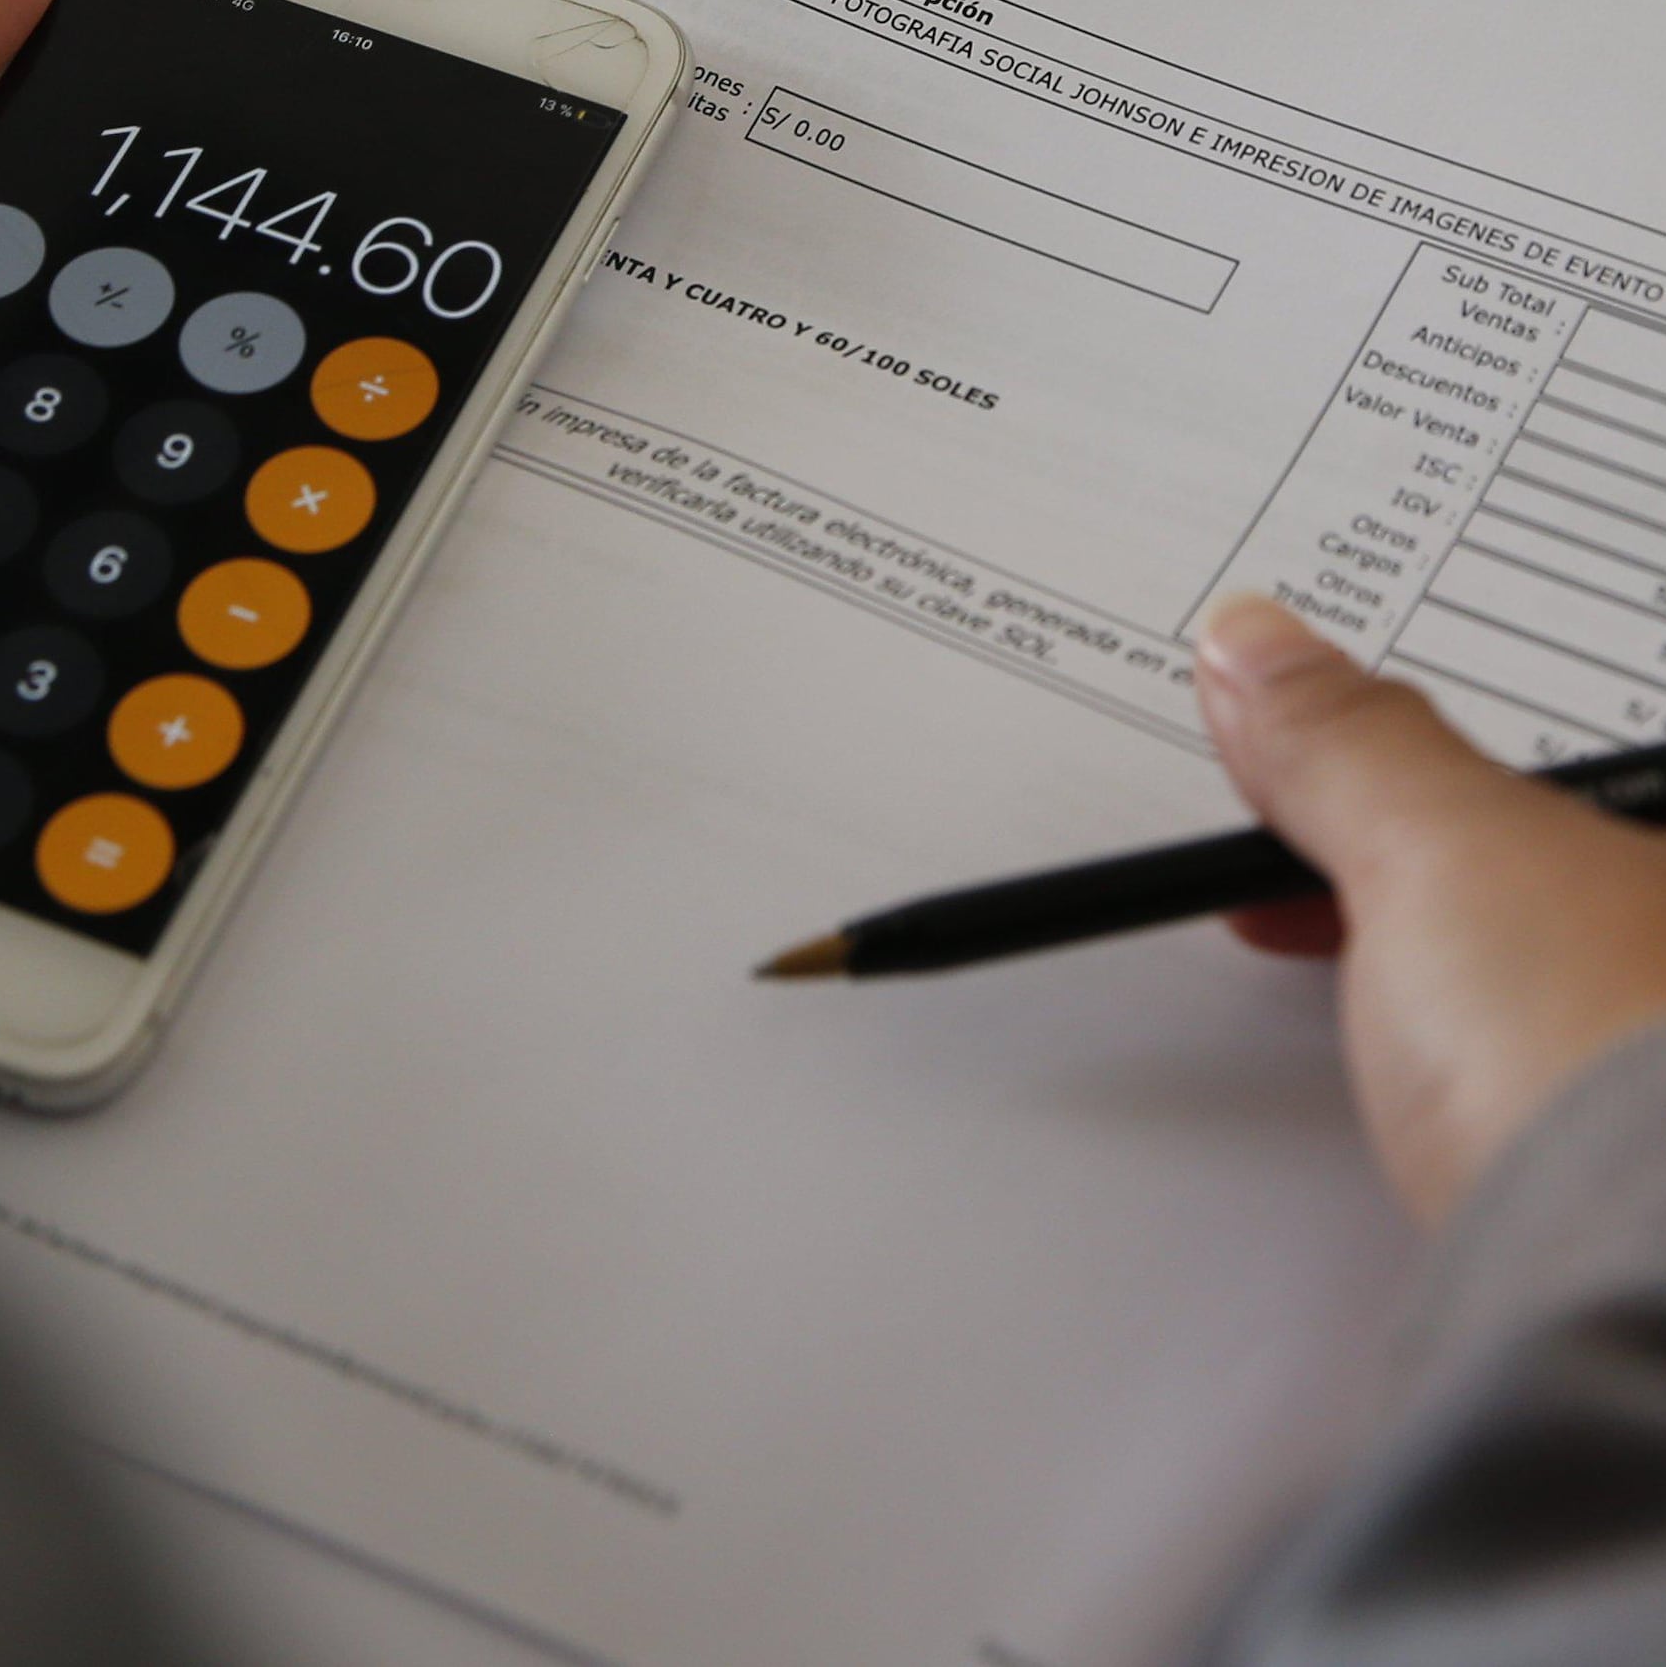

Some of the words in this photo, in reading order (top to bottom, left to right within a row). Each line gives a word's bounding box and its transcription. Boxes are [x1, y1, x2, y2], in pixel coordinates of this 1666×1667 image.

[332, 28, 374, 51] 16:10
[538, 97, 557, 112] 13
[761, 106, 791, 130] S/
[793, 120, 846, 152] 0.00
[979, 48, 1064, 94] SOCIAL
[1068, 83, 1185, 137] JOHNSON
[1189, 126, 1208, 145] E
[1210, 135, 1346, 195] IMPRESION
[1349, 182, 1387, 208] DE
[1389, 196, 1521, 252] IMAGENES
[1524, 241, 1560, 267] DE
[1565, 256, 1665, 304] EVENTO
[90, 124, 503, 320] 1,144.60
[1442, 265, 1489, 294] Sub
[1499, 282, 1557, 317] Total
[665, 273, 684, 291] Y
[685, 282, 787, 331] CUATRO
[794, 322, 812, 338] Y
[814, 330, 911, 378] 60/100
[913, 368, 1001, 411] SOLES
[1461, 301, 1539, 343] Ventas
[1411, 325, 1522, 376] Anticipos
[24, 386, 63, 423] 8
[1362, 350, 1501, 412] Descuentos
[1344, 385, 1407, 420] Valor
[1412, 409, 1481, 447] Venta
[158, 434, 196, 471] 9
[1413, 453, 1464, 485] ISC
[1391, 487, 1443, 517] IGV
[89, 545, 128, 585] 6
[17, 661, 58, 702] 3
